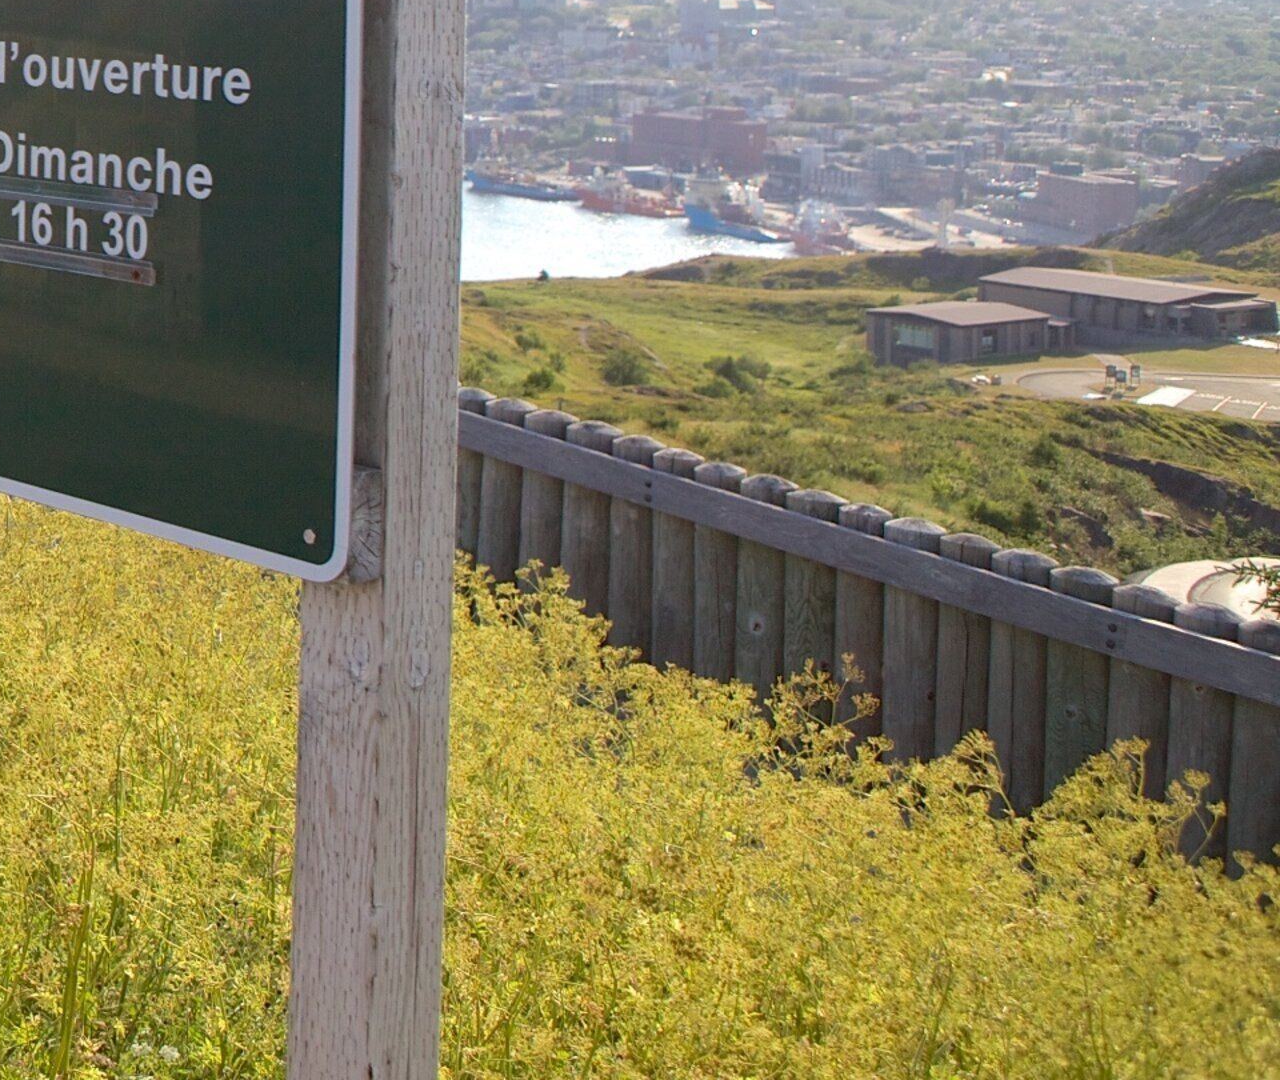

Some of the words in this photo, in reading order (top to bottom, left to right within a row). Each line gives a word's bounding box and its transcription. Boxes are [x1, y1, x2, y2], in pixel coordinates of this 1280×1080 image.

[11, 200, 52, 246] 16
[66, 206, 88, 251] h
[102, 212, 148, 259] 30
